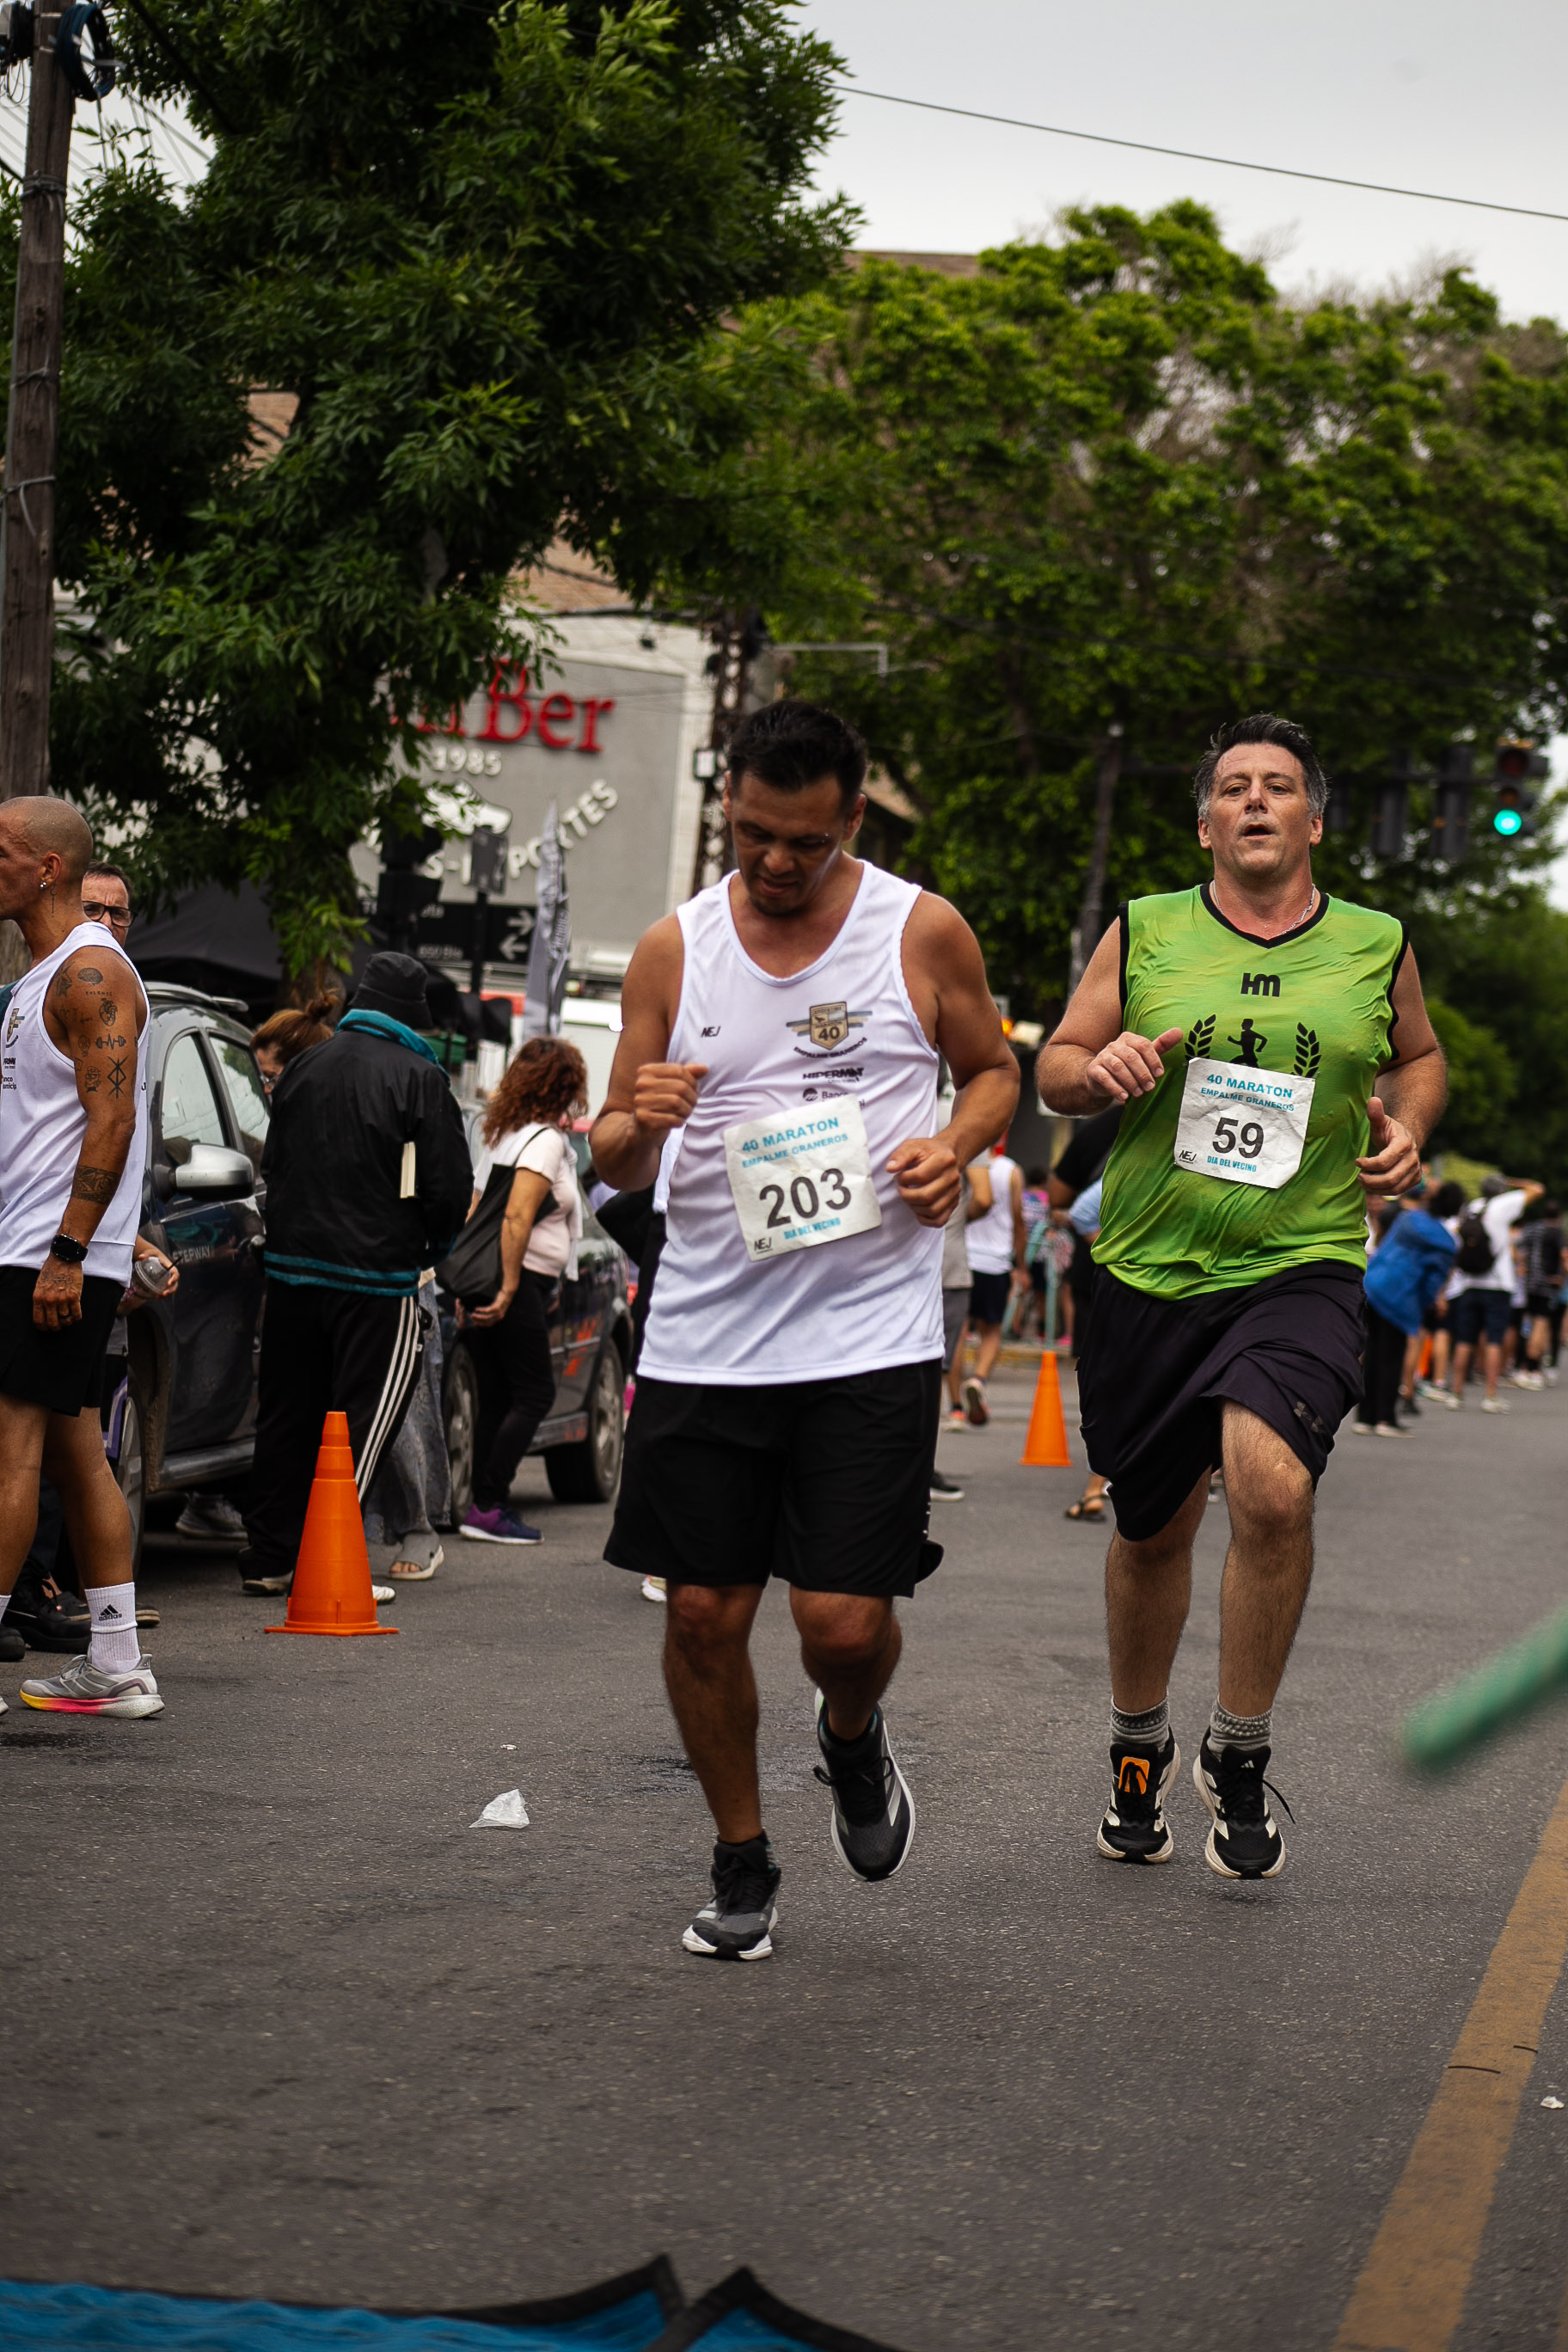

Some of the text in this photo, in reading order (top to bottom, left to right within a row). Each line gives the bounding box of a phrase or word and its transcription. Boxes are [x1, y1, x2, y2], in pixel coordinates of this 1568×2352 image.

[432, 745, 503, 775] 1985
[818, 1026, 841, 1040] 40
[1207, 1074, 1293, 1098] 40 MARATON
[1201, 1087, 1295, 1112] EMPALME GRANEROS
[742, 1118, 840, 1153] 40 MARATON
[1212, 1117, 1265, 1159] 59
[742, 1133, 848, 1168] EMPALME GRANEROS
[1179, 1149, 1197, 1161] NEJ
[1207, 1155, 1257, 1173] DIA DEL VECINO
[758, 1167, 852, 1229] 203
[784, 1217, 841, 1240] DIA DEL VECINO
[754, 1238, 772, 1252] NEJ
